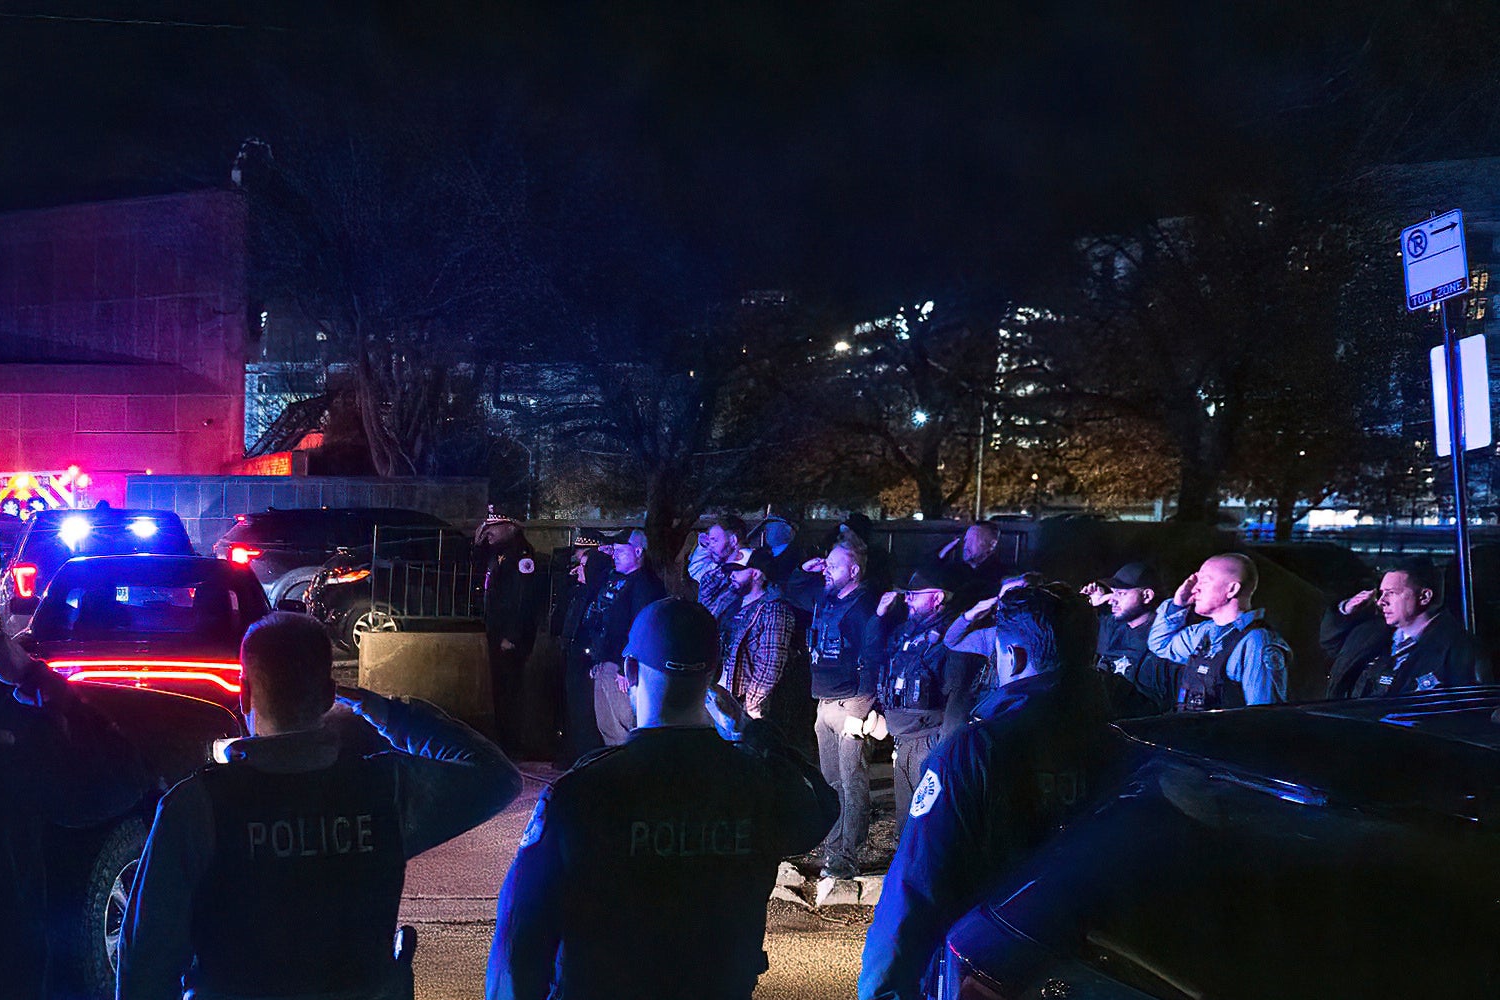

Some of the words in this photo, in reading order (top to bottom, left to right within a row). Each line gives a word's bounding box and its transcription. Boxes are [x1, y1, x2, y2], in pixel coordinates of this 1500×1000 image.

[1411, 291, 1432, 306] TOW
[1435, 280, 1463, 298] ZONE
[246, 814, 374, 859] POLICE
[629, 817, 757, 857] POLICE
